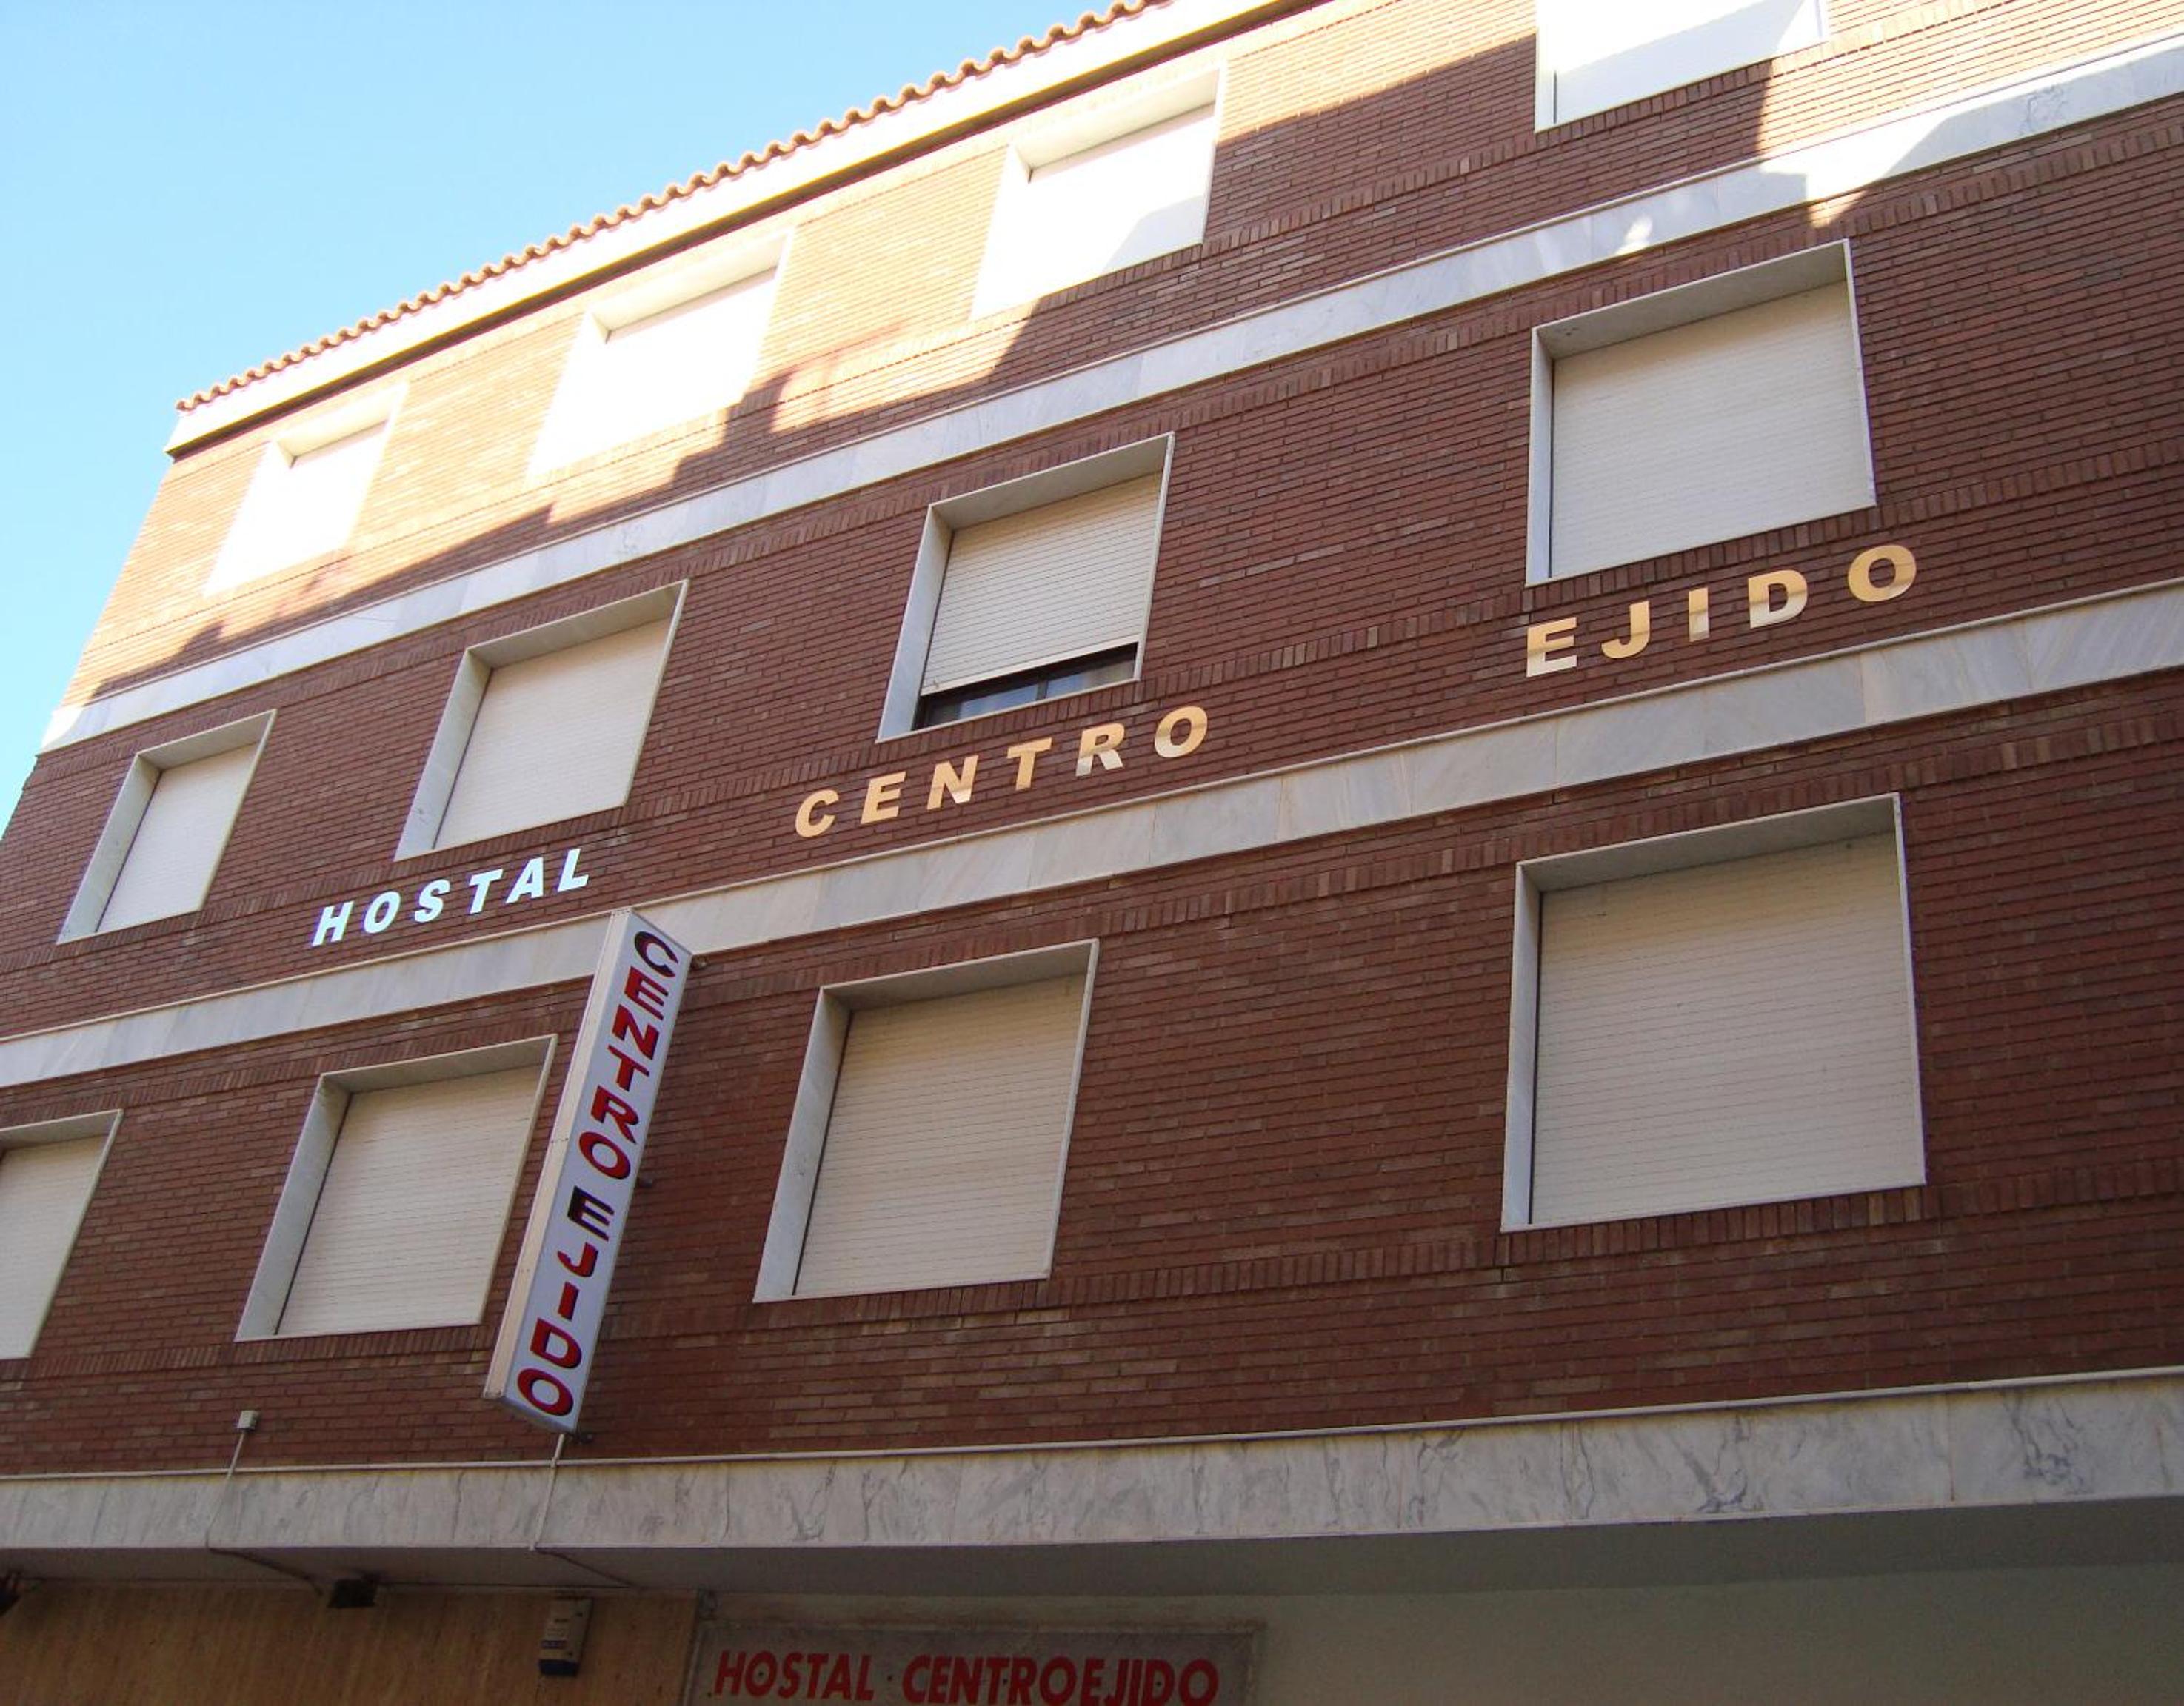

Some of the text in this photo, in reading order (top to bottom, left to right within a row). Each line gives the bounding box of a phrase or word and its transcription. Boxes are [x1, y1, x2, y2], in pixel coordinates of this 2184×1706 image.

[311, 544, 1917, 947] HOSTAL CENTRO EJIDO
[516, 931, 679, 1416] CENTRO EJIDO
[713, 1650, 875, 1701] HOSTAL
